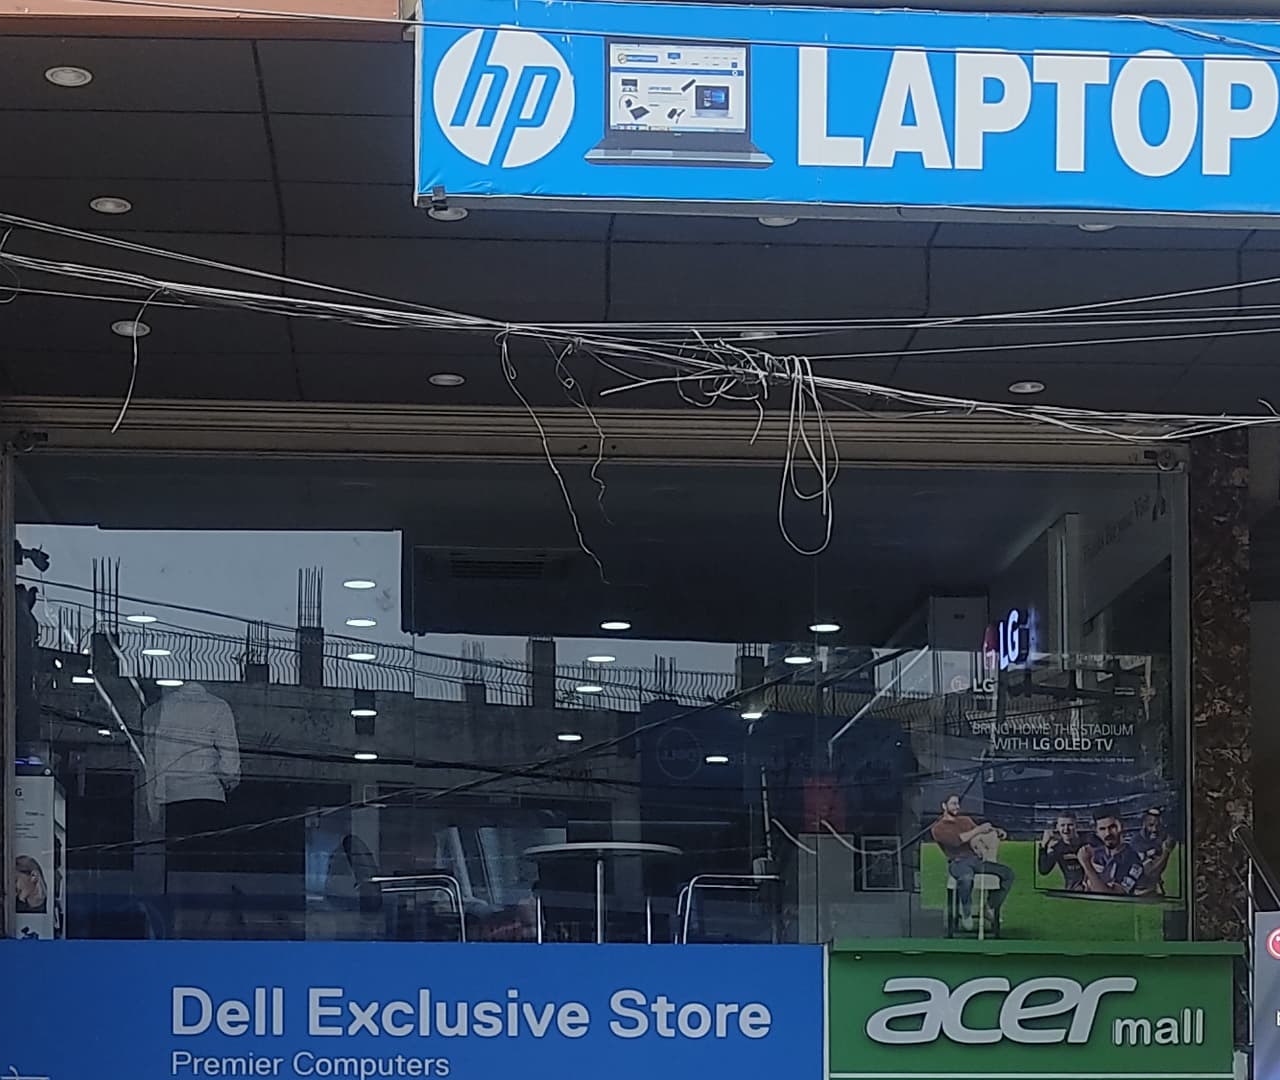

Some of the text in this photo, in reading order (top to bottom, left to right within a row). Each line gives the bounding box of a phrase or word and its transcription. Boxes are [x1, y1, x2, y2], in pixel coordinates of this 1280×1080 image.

[442, 28, 570, 168] hp
[797, 45, 1280, 178] LAPTOP
[999, 607, 1019, 670] LG
[992, 737, 1114, 751] WITH LG OLED TV
[171, 986, 772, 1040] Dell Exclusive Store
[865, 977, 1204, 1046] acer mall
[171, 1051, 285, 1077] Premier
